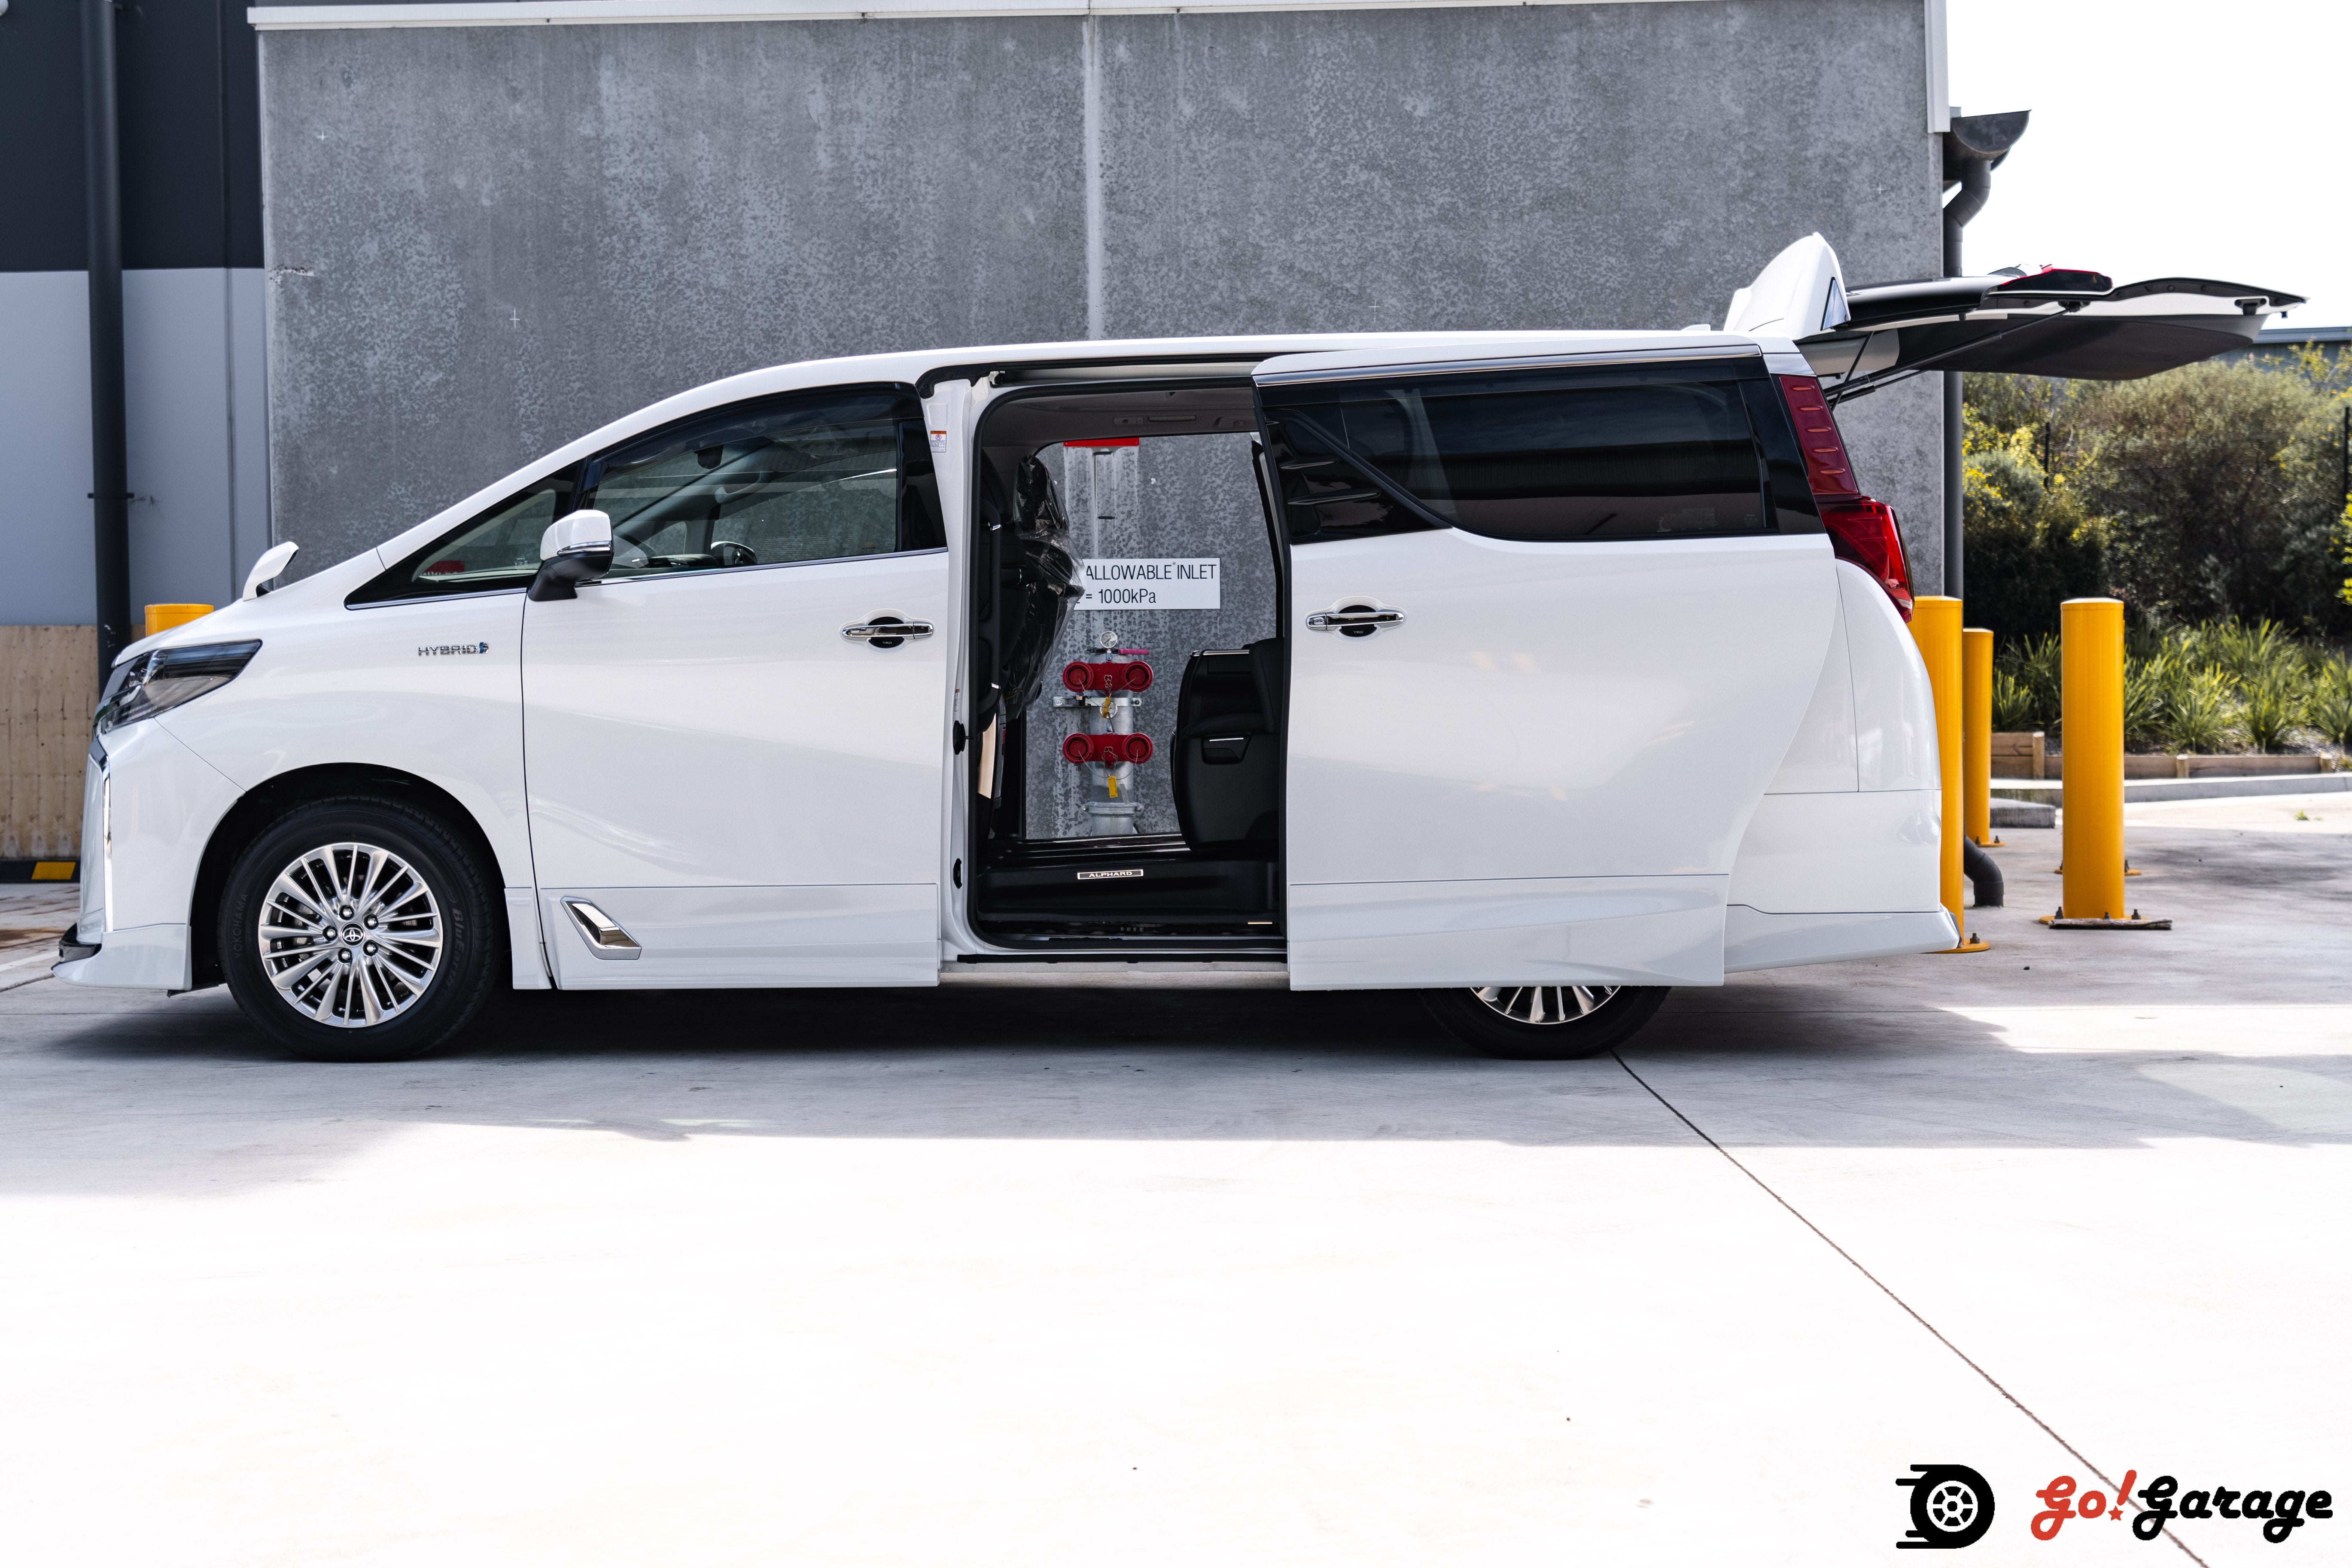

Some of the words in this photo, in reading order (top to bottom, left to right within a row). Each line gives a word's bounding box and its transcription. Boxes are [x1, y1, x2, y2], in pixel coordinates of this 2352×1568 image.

[1086, 565, 1172, 580] ALLOWABLE
[1177, 564, 1217, 579] INLET
[1098, 588, 1156, 603] 1000kPa
[418, 645, 477, 656] HYBRID
[233, 894, 248, 958] YOKOHAMA
